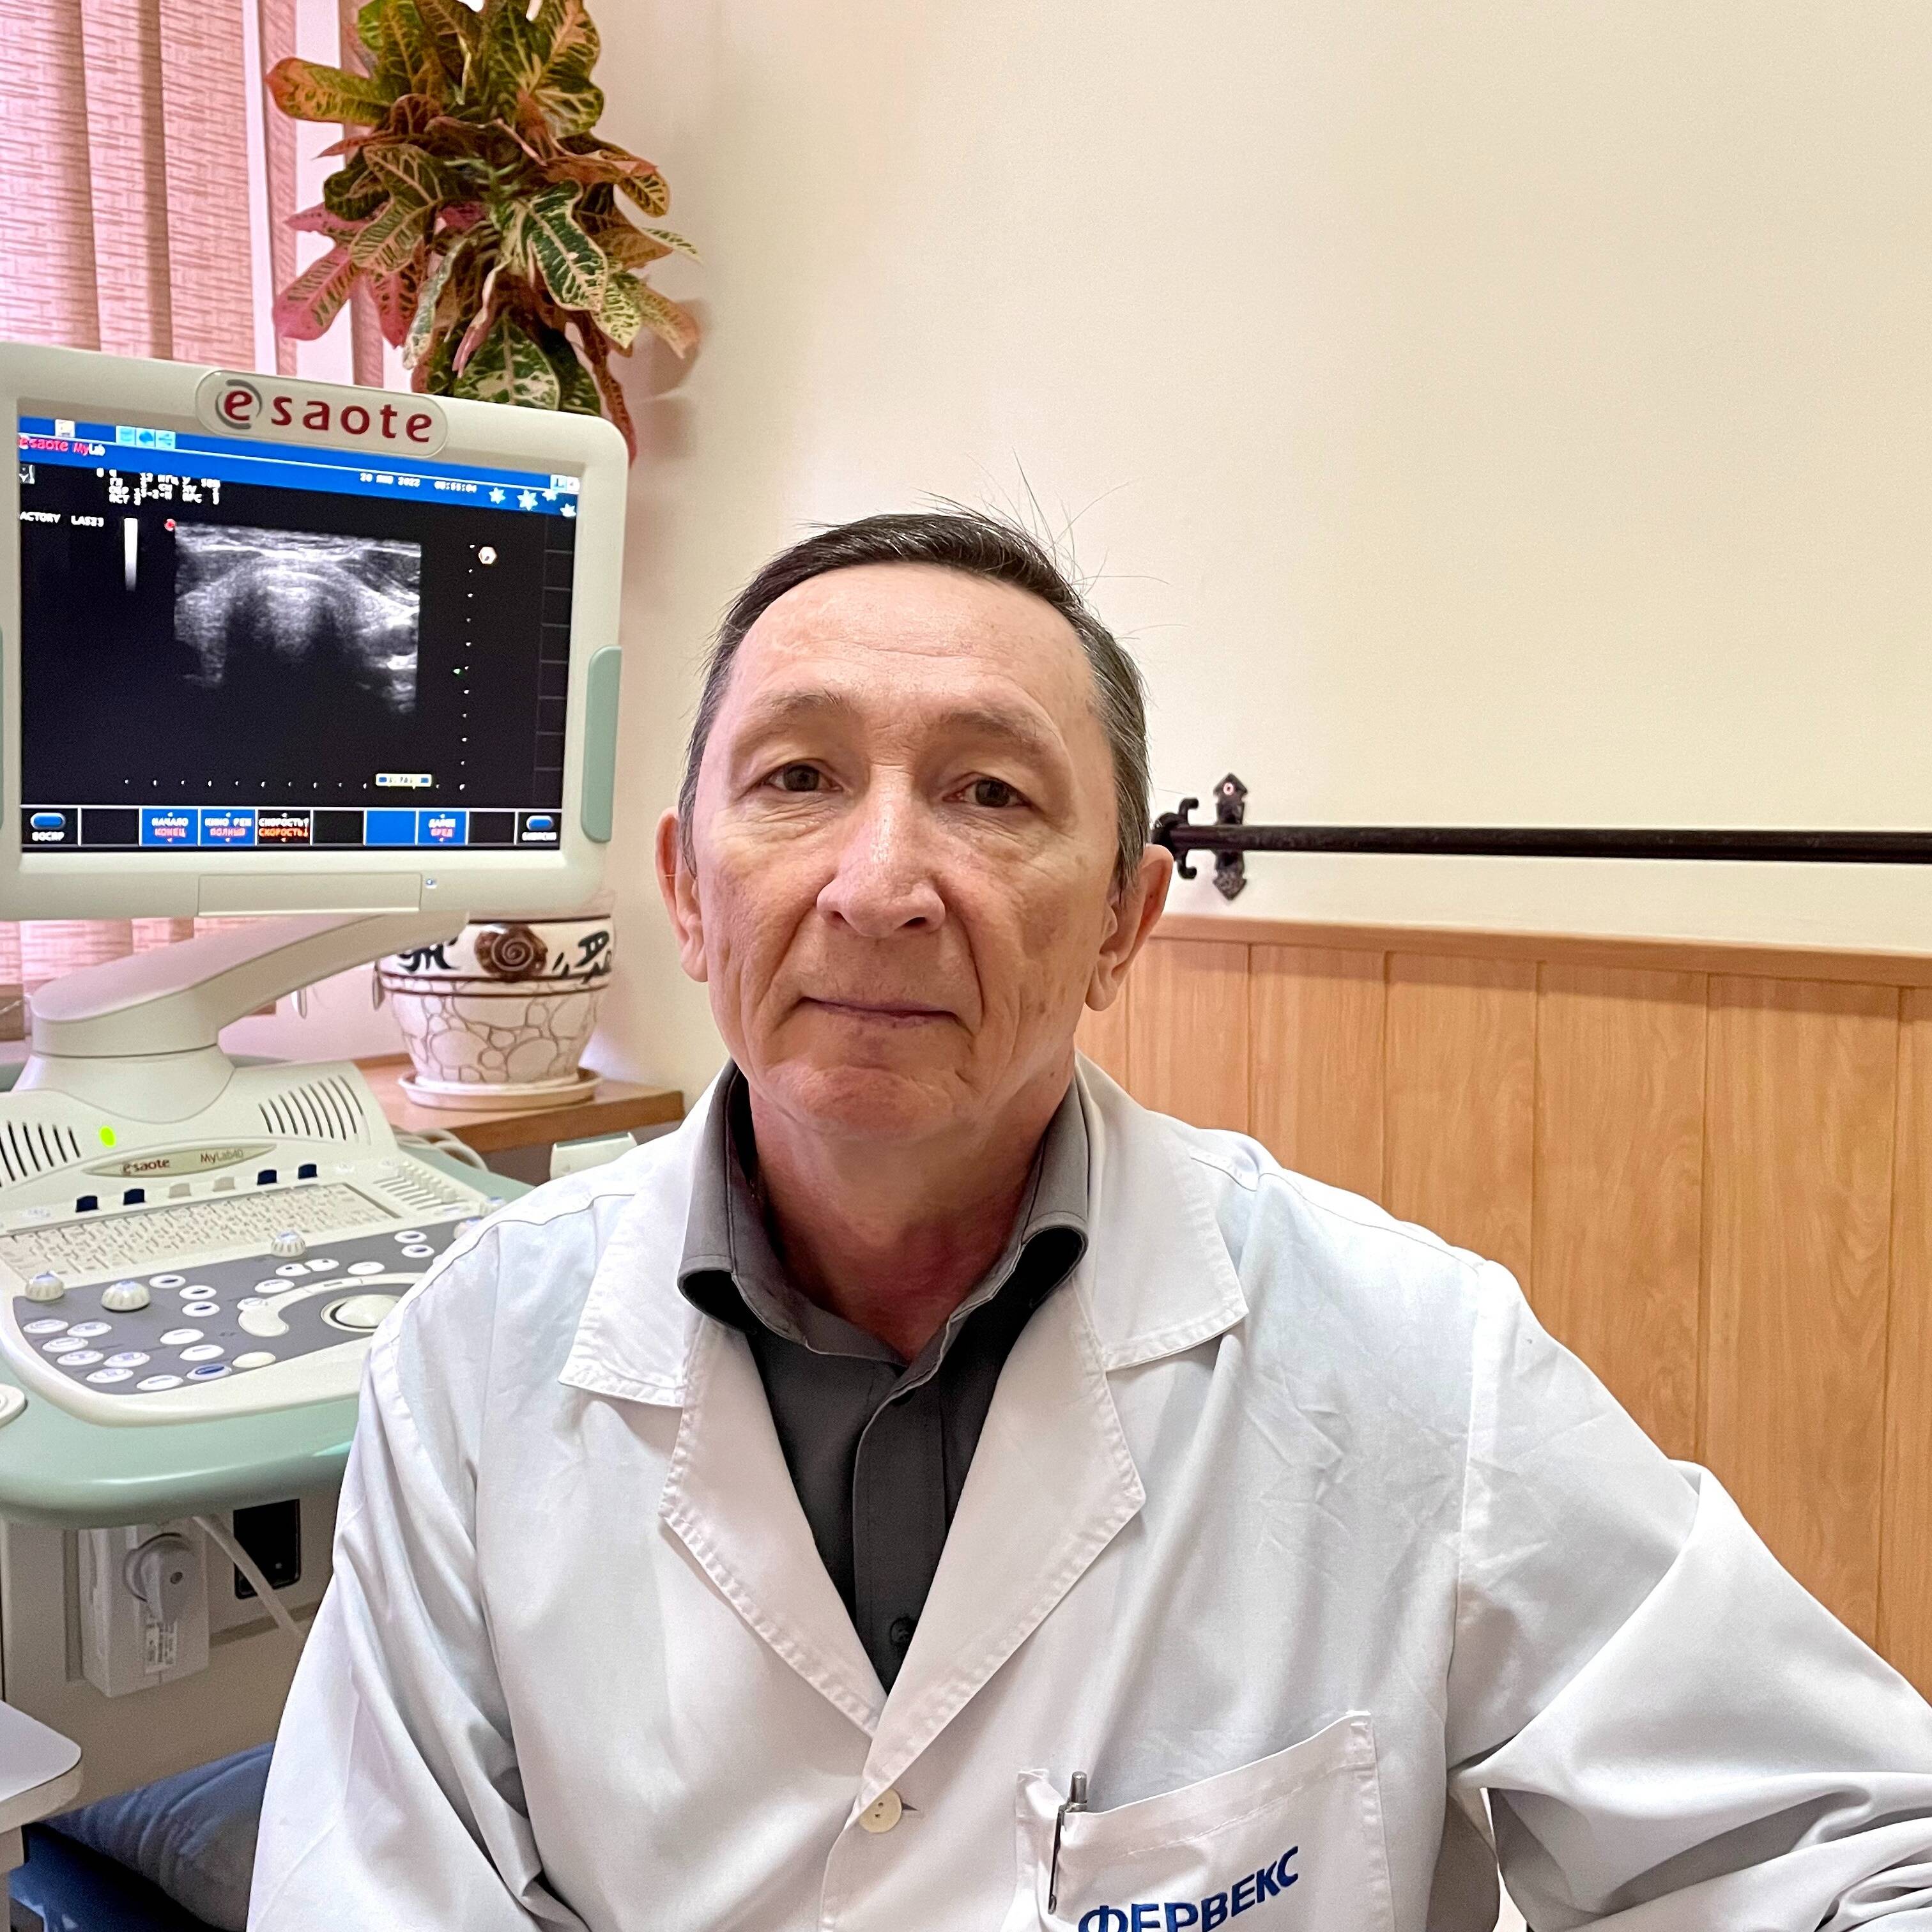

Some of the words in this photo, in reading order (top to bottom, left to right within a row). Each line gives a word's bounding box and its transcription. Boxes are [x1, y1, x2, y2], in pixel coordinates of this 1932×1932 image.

[222, 388, 433, 443] esaote
[18, 434, 68, 452] esaote
[122, 1159, 171, 1176] esaote
[1078, 1846, 1299, 1932] ФЕРВЕКС
